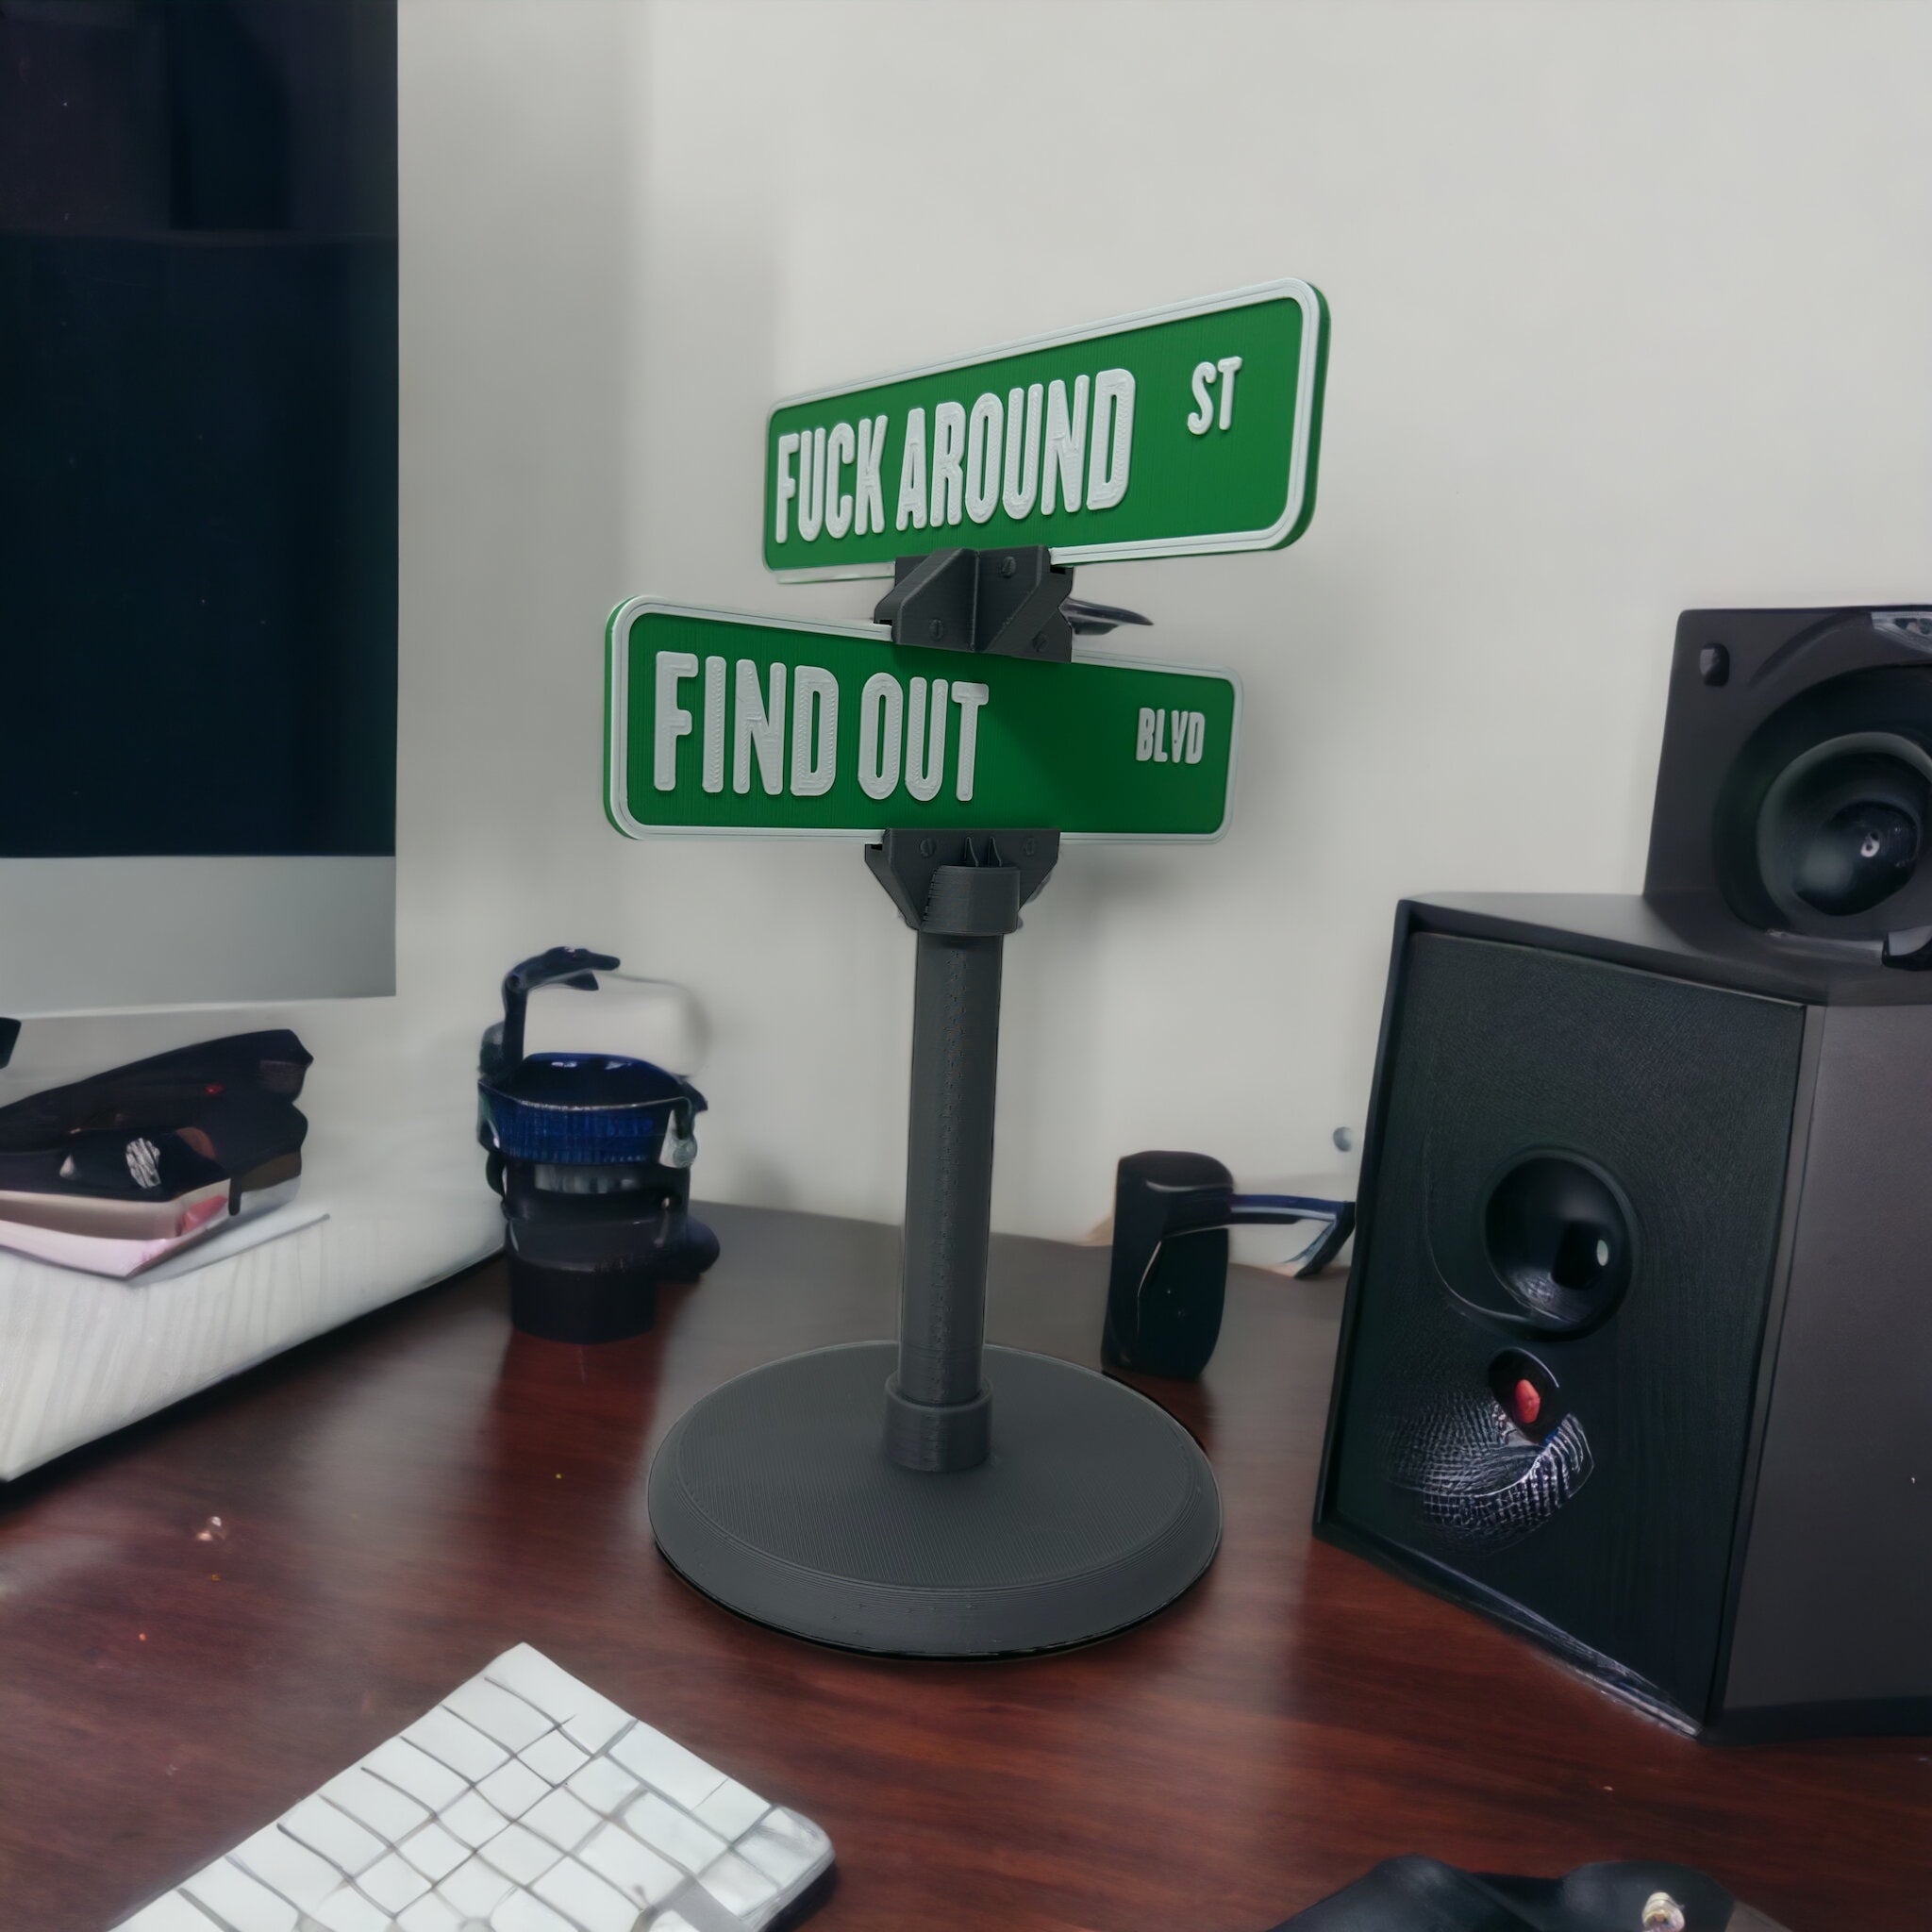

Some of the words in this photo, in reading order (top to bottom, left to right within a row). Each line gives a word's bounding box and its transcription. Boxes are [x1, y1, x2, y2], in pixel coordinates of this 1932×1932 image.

[775, 415, 889, 544] FUCK
[895, 367, 1137, 532] AROUND
[1187, 356, 1242, 436] ST
[653, 650, 840, 797] FIND
[858, 672, 990, 802] OUT
[1136, 707, 1206, 764] BLVD
